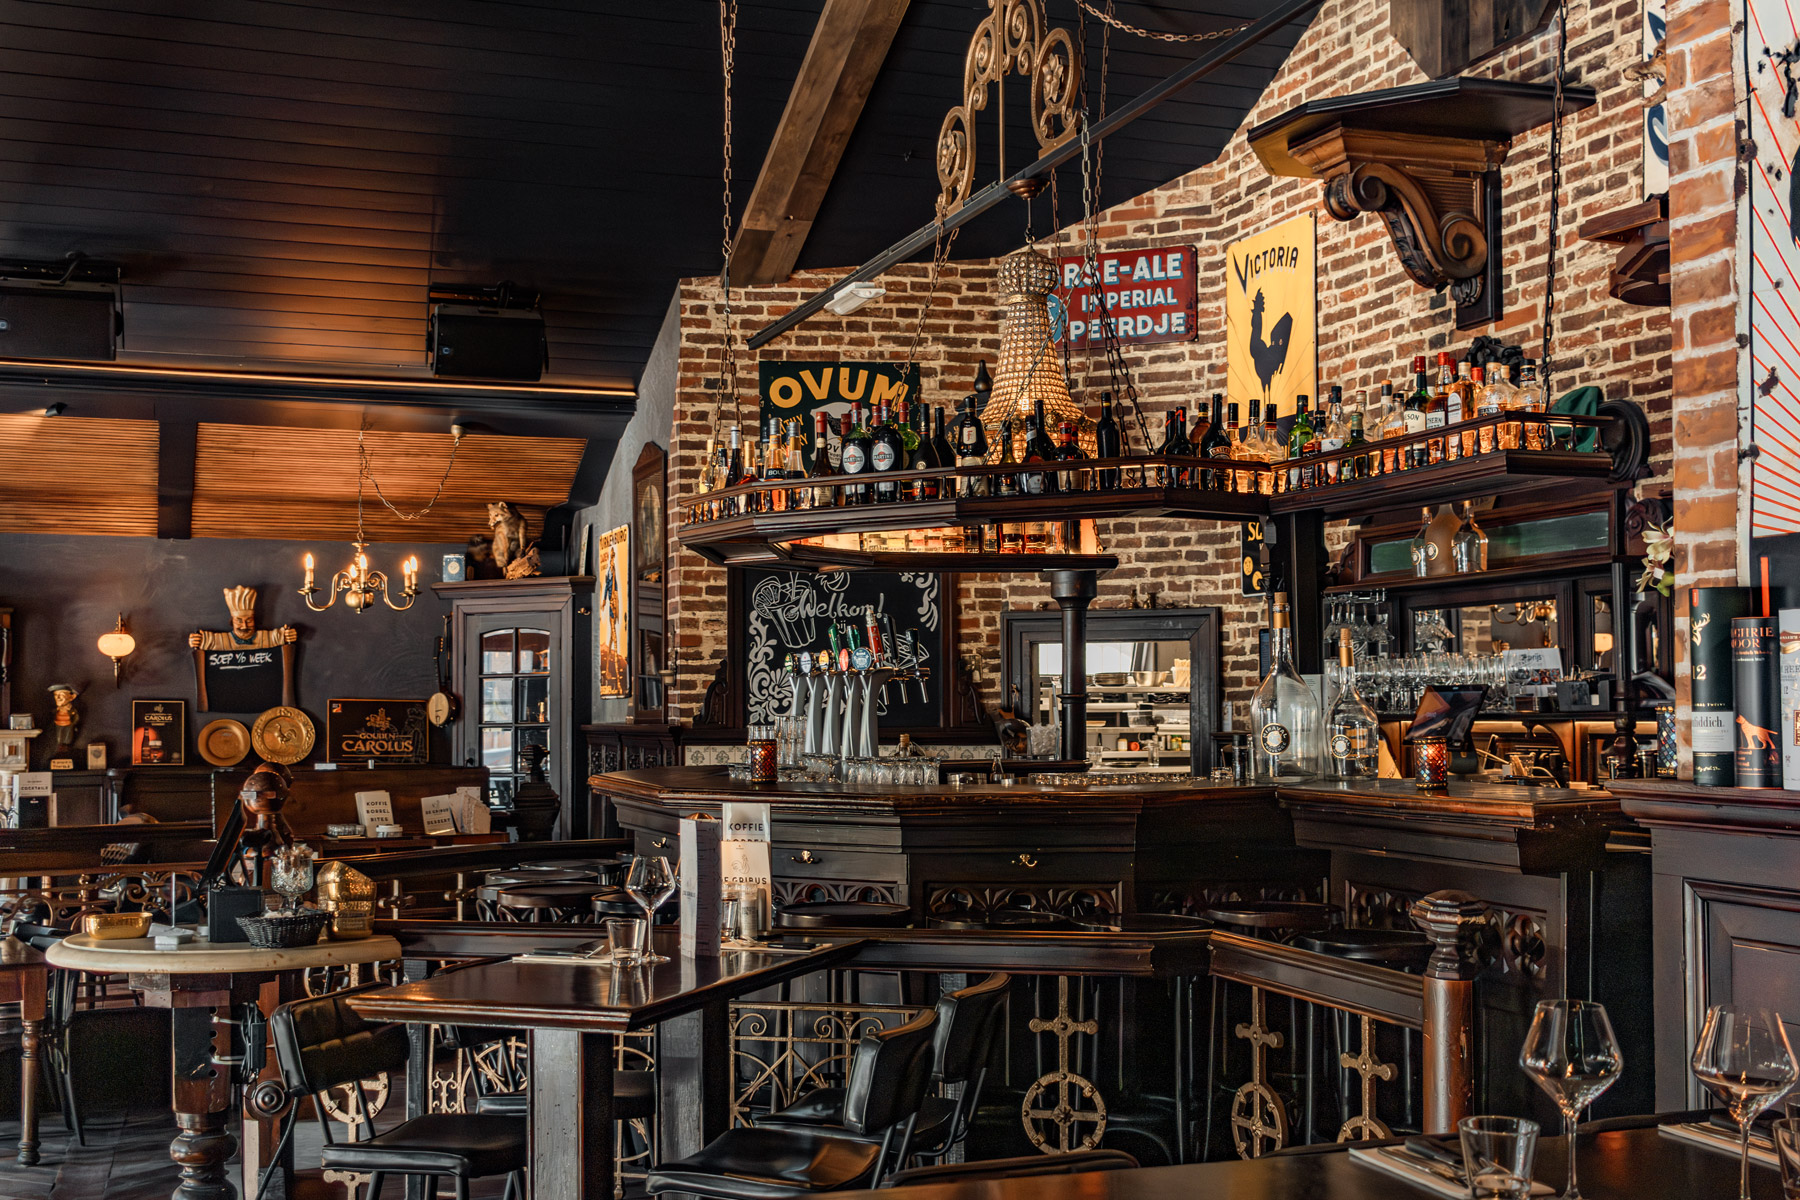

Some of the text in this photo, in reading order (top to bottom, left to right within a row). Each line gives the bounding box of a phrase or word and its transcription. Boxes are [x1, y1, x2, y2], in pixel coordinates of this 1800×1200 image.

[1057, 252, 1184, 290] RSE-ALE
[1232, 246, 1299, 295] VICTORIA
[1069, 312, 1187, 343] PEERDJE
[769, 367, 909, 413] OVUM
[844, 456, 864, 464] MARTINI
[873, 452, 893, 461] MARTINI
[786, 587, 885, 622] Welkom!
[1731, 638, 1761, 649] OOR
[209, 653, 234, 666] SOEP
[249, 651, 273, 664] WEEK
[341, 740, 414, 755] CAROLUS
[728, 822, 764, 832] KOFFIE
